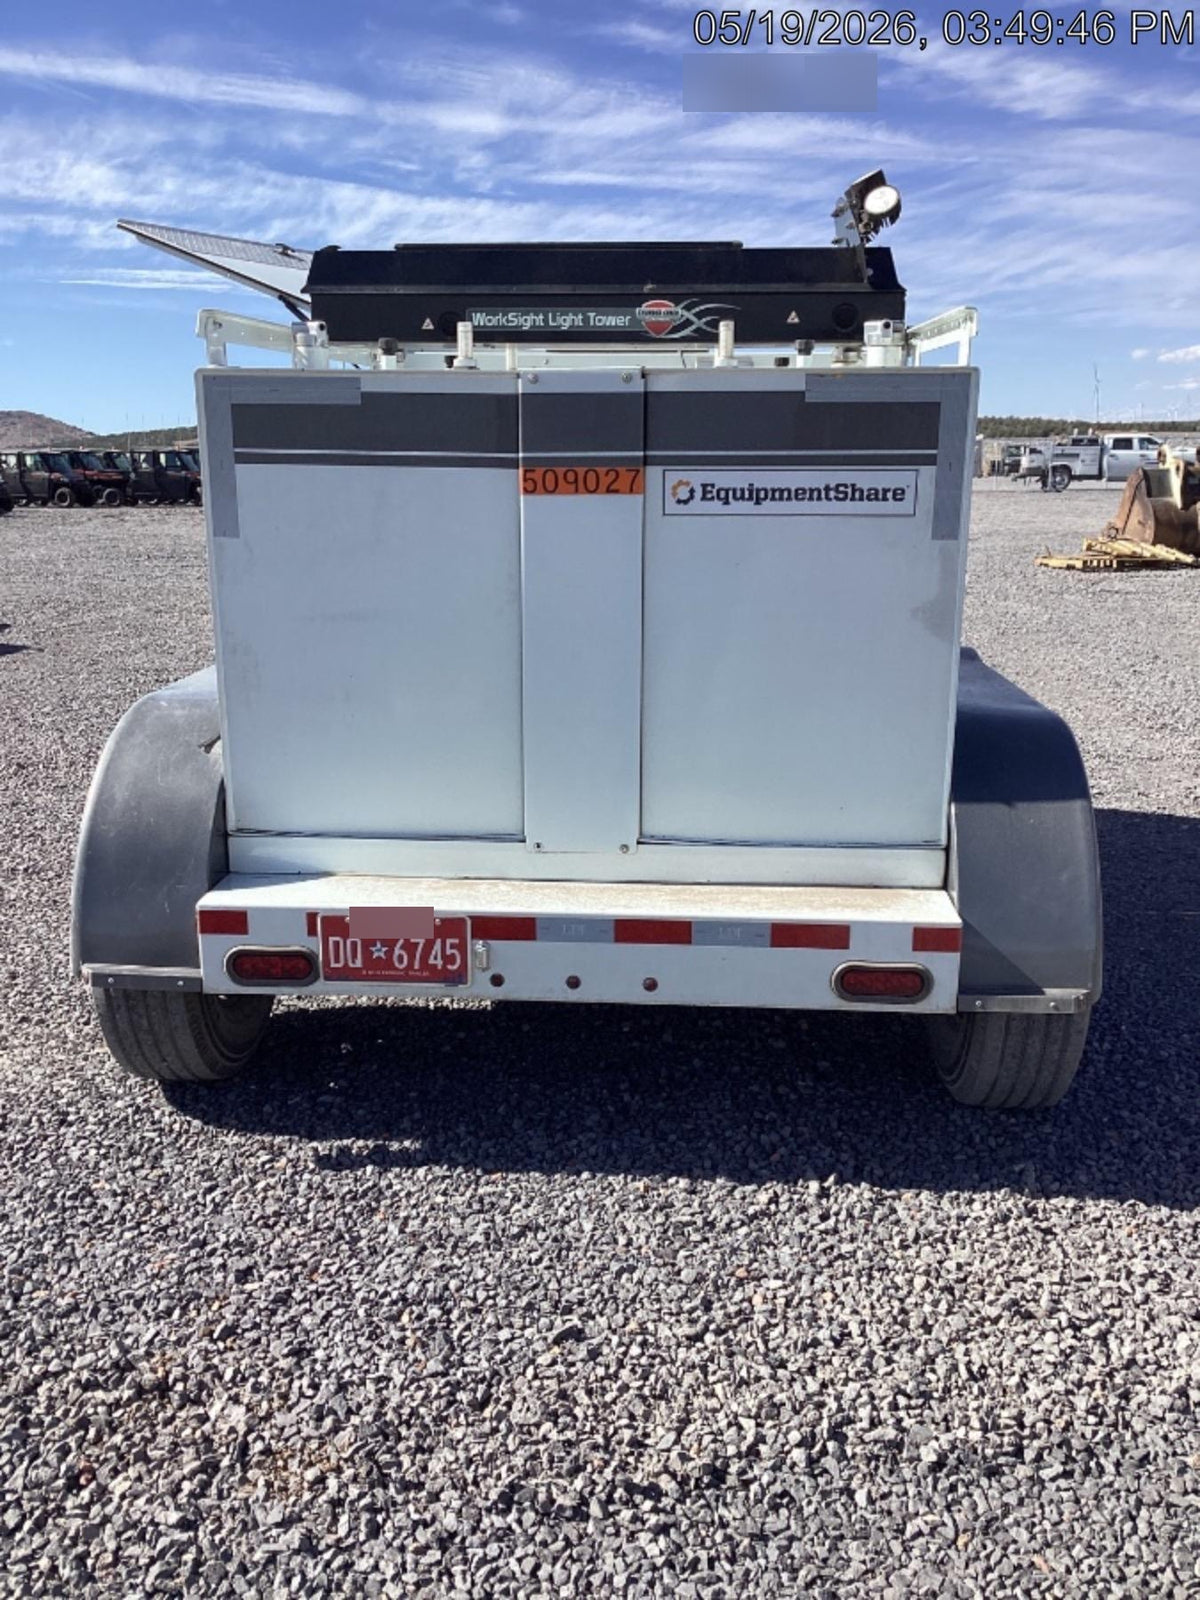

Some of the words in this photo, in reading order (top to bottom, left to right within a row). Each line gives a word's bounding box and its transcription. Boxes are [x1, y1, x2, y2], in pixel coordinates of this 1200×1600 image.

[472, 312, 544, 330] WorkSight
[549, 312, 583, 330] Light
[586, 312, 631, 327] Tower
[522, 468, 641, 494] 509027
[700, 482, 906, 506] EquipmentShare
[393, 938, 462, 970] 6745
